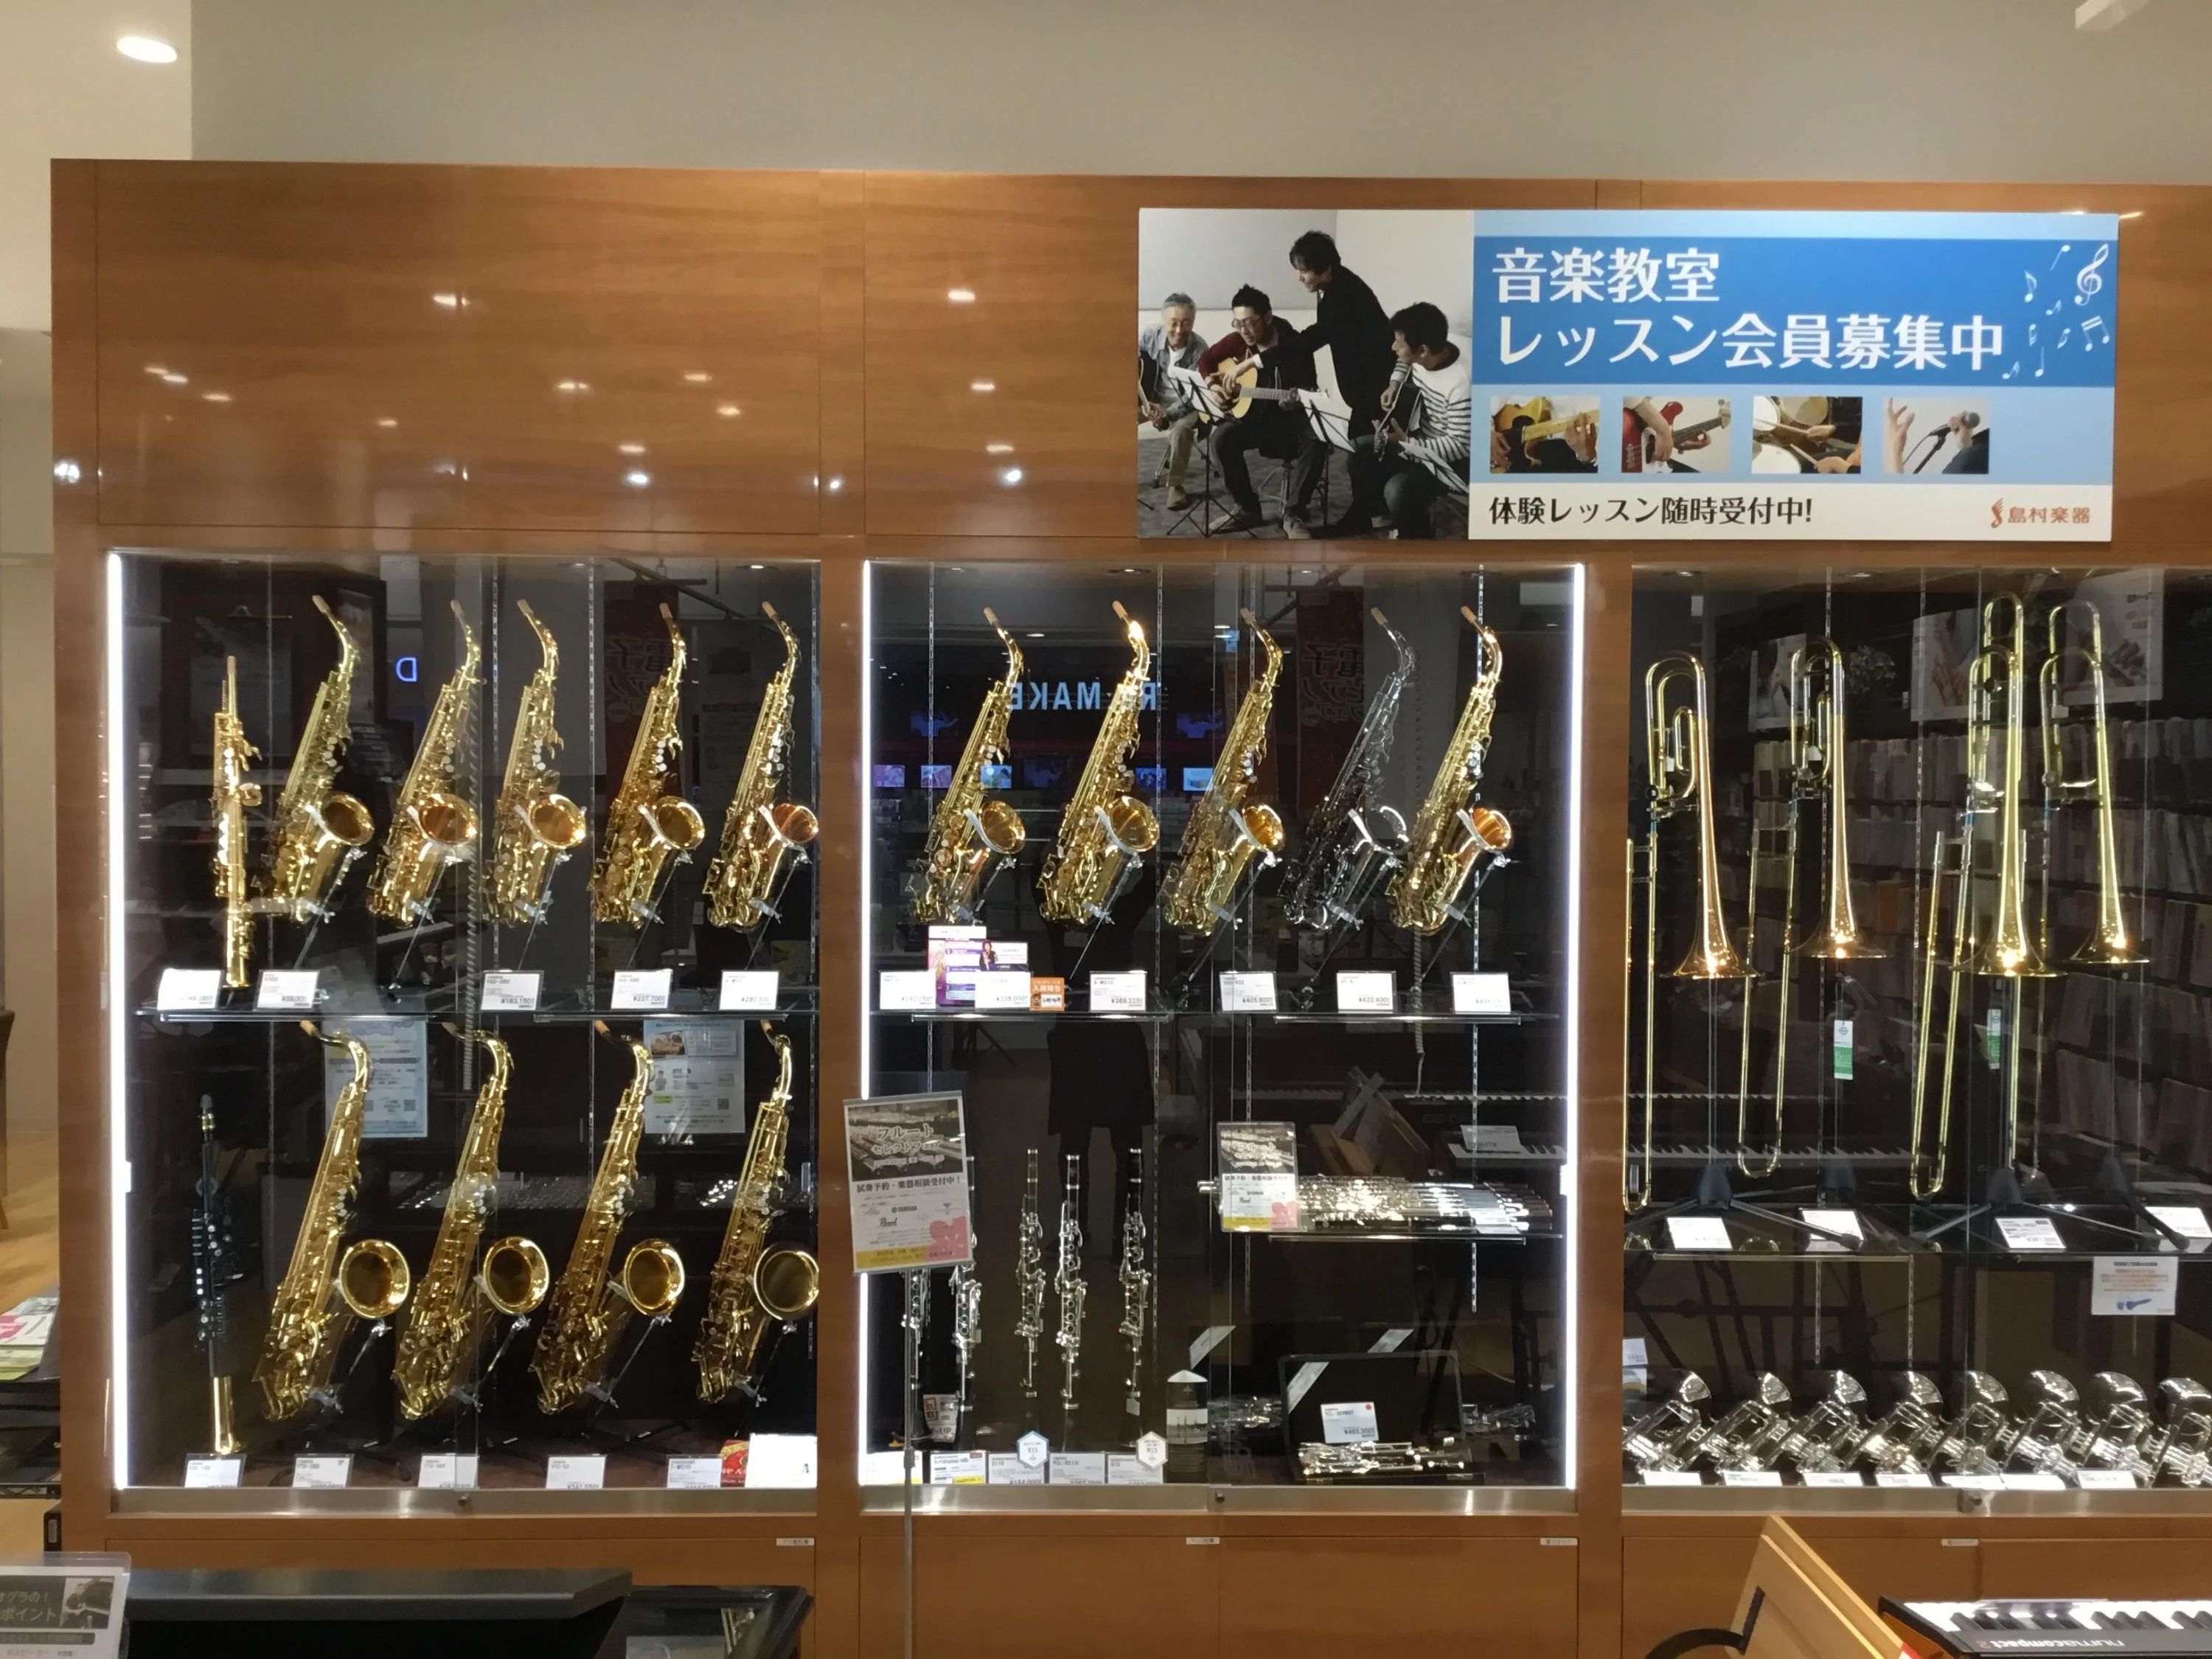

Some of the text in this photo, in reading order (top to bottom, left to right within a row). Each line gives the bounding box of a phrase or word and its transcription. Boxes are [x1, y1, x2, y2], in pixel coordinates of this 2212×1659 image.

[1491, 246, 1721, 305] 音楽教室
[1498, 312, 2003, 372] レッスン会員募集中
[1489, 496, 1812, 526] 体験レッスン随時受付中!
[2008, 507, 2092, 525] 島村楽器
[877, 1123, 934, 1141] フルート
